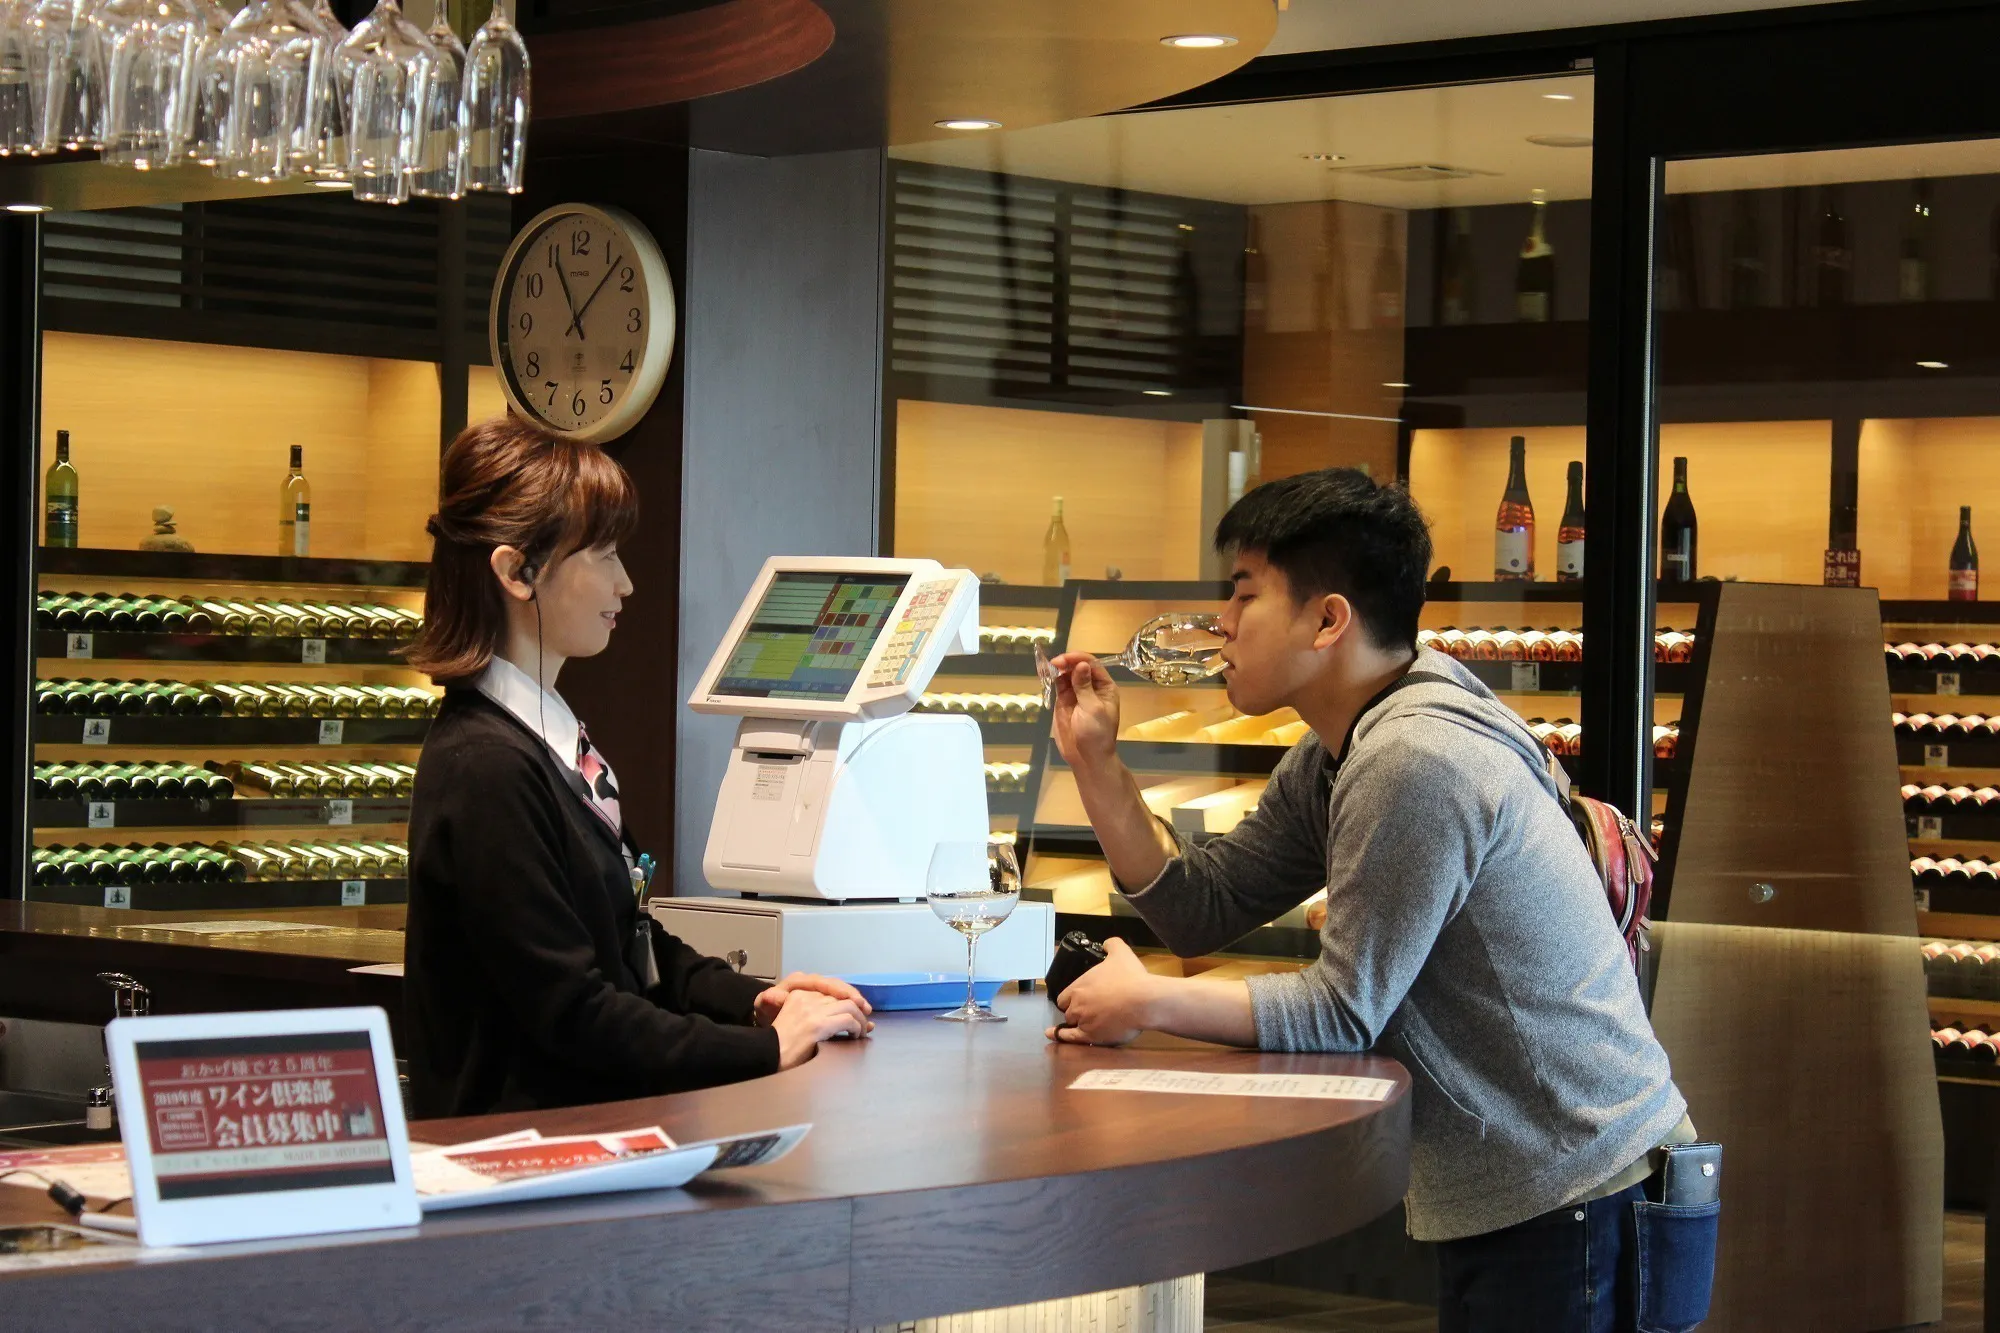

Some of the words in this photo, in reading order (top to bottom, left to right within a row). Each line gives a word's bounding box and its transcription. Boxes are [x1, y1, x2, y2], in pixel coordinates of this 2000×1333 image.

[571, 230, 591, 256] 12
[605, 240, 611, 265] 1
[526, 272, 544, 299] 10
[620, 266, 635, 293] 2
[519, 312, 533, 339] 9
[626, 307, 642, 333] 3
[525, 351, 540, 378] 8
[619, 349, 635, 374] 4
[544, 381, 559, 406] 7
[572, 389, 586, 417] 6
[599, 379, 614, 405] 5
[208, 1078, 335, 1109] ワイン倶楽部
[214, 1109, 341, 1148] 会員募集中
